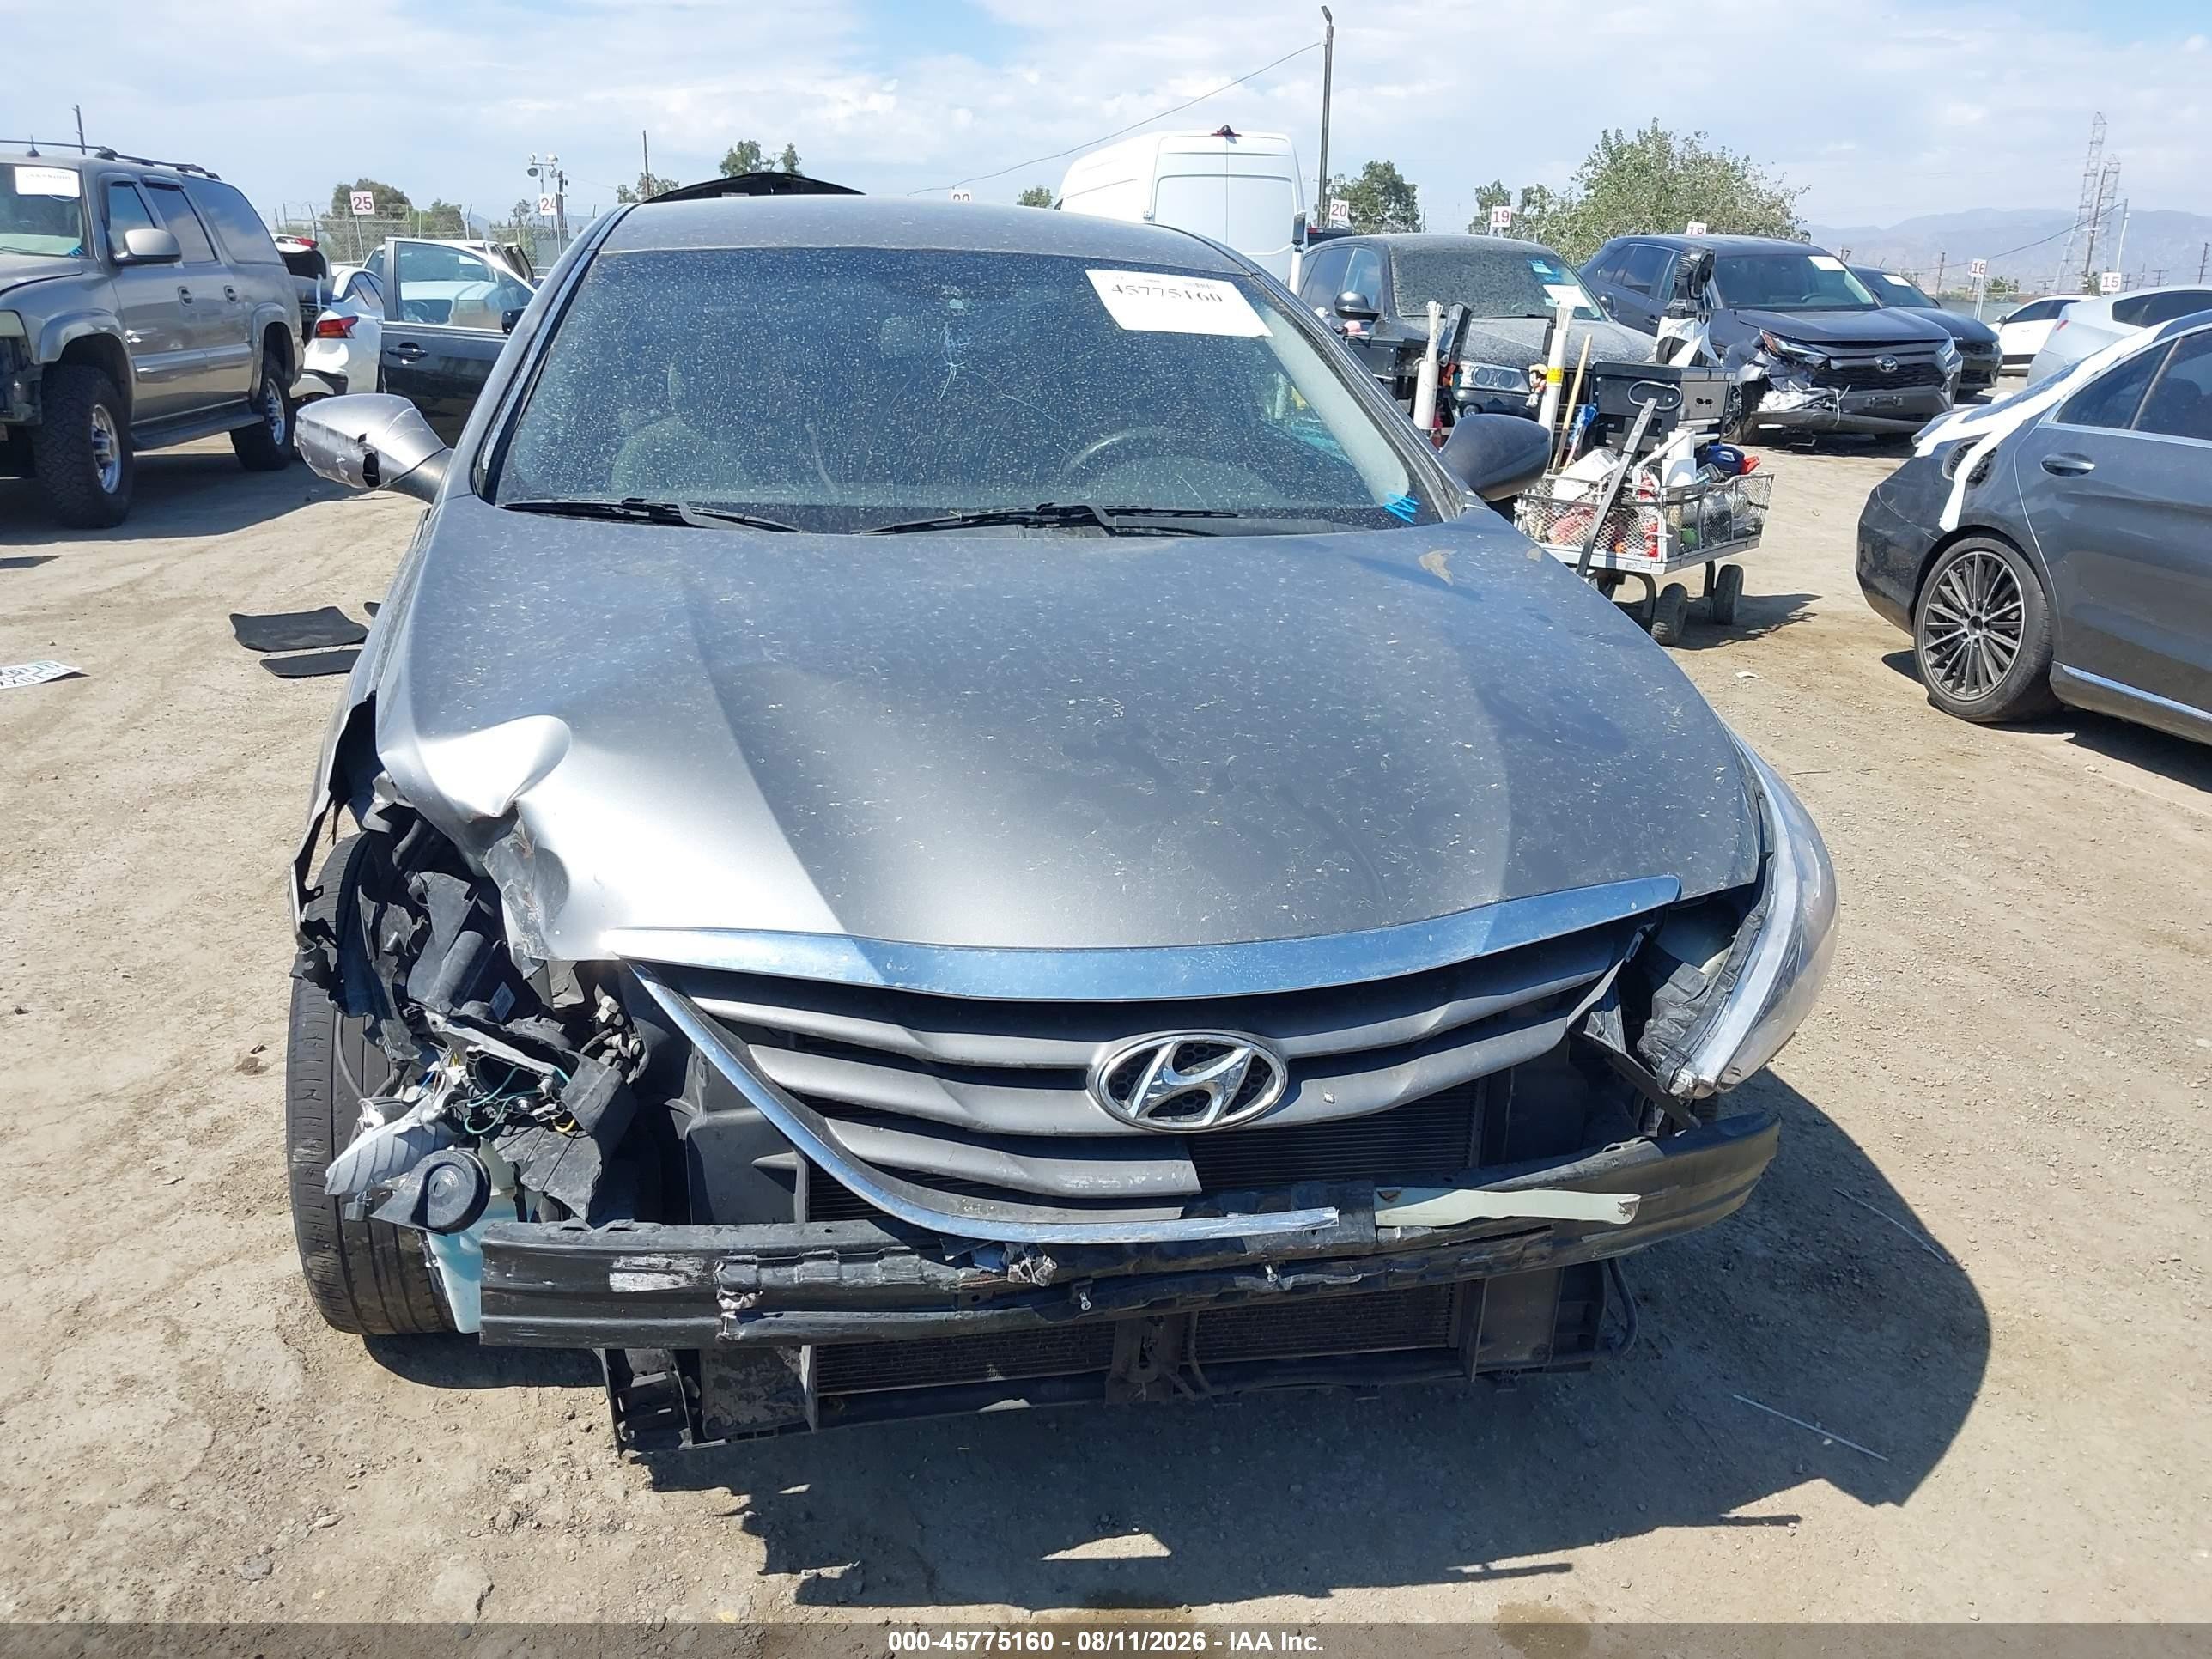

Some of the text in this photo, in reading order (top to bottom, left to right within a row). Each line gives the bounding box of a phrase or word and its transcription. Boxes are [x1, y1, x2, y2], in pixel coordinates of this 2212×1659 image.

[353, 196, 373, 210] 25
[541, 198, 556, 211] 24
[1332, 203, 1347, 217] 20
[1492, 210, 1510, 223] 19
[1840, 248, 1852, 262] 17
[1972, 262, 1985, 275] 16
[2102, 276, 2119, 288] 15
[1111, 284, 1224, 302] 45775160
